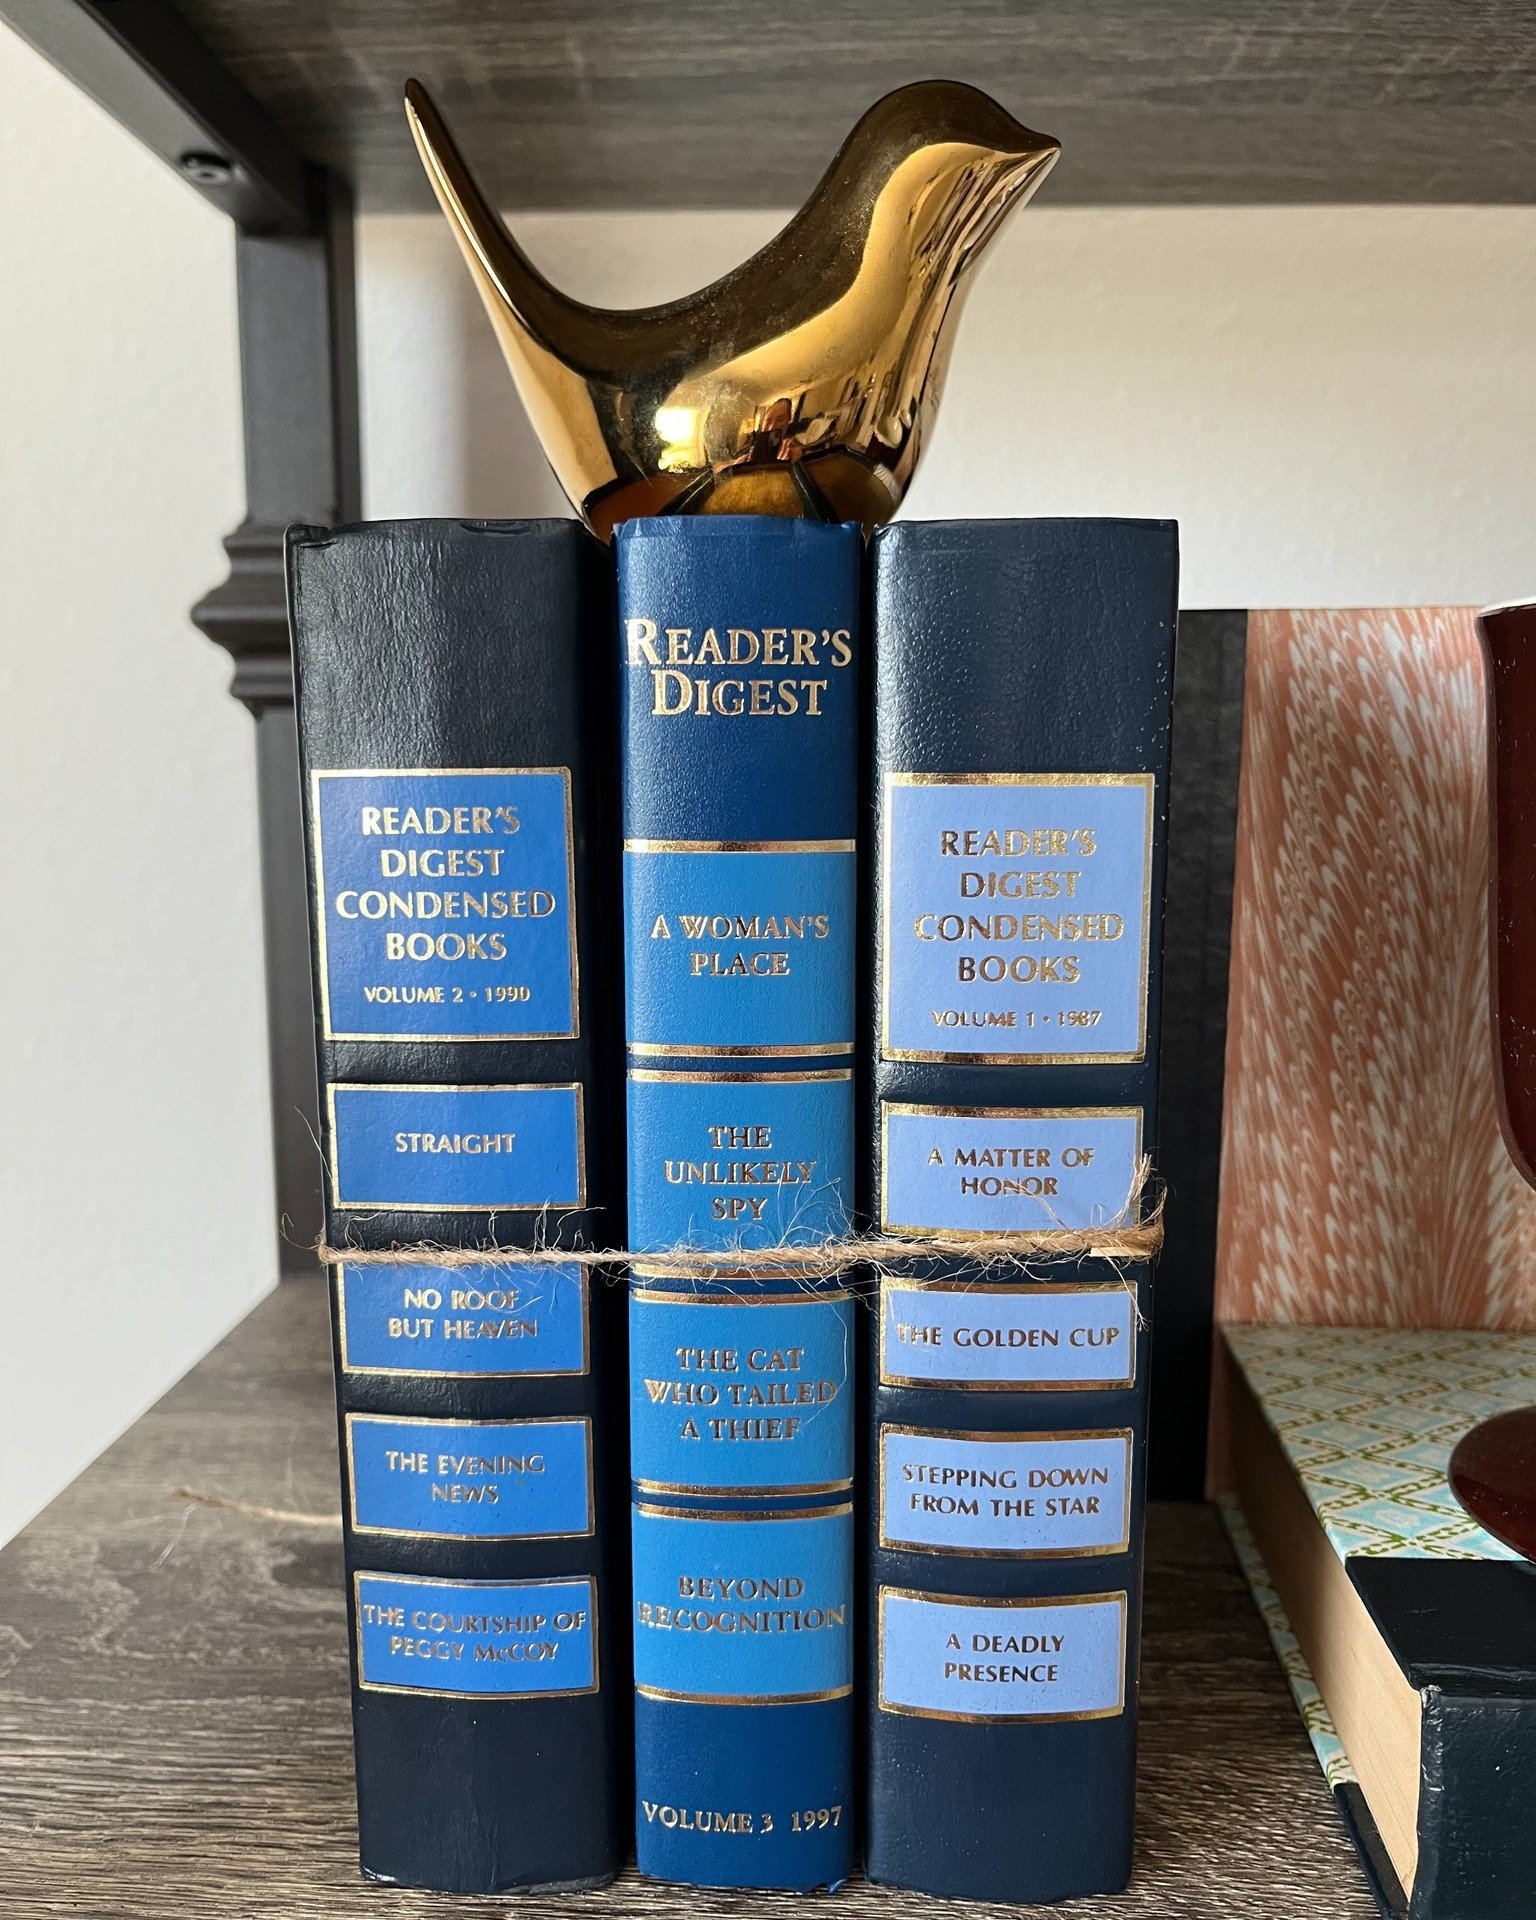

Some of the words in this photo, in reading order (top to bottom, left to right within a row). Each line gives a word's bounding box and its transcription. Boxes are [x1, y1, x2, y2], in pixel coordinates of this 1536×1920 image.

[624, 618, 852, 667] READER'S
[650, 669, 828, 716] DIGEST
[361, 806, 520, 835] READER'S
[940, 828, 1097, 857] READER'S
[380, 849, 504, 877] DIGEST
[960, 871, 1081, 899] DIGEST
[335, 890, 556, 919] CONDENSED
[651, 915, 671, 939] A
[679, 914, 830, 940] WOMAN'S
[914, 913, 1125, 942] CONDENSED
[386, 933, 507, 961] BOOKS
[690, 952, 790, 976] PLACE
[958, 956, 1081, 983] BOOKS
[363, 986, 445, 1003] VOLUME
[452, 987, 464, 1003] 2
[485, 986, 530, 1002] 1990
[931, 1010, 1017, 1028] VOLUME
[1026, 1012, 1036, 1027] 1
[1057, 1010, 1102, 1028] 1987
[395, 1133, 516, 1154] STRAIGHT
[707, 1126, 773, 1150] THE
[927, 1146, 944, 1166] A
[954, 1147, 1051, 1168] MATTER
[1061, 1148, 1095, 1168] OF
[663, 1160, 817, 1185] UNLIKELY
[961, 1177, 1058, 1196] HONOR
[711, 1197, 768, 1221] SPY
[403, 1288, 442, 1310] NO
[451, 1289, 519, 1310] ROOF
[388, 1318, 434, 1338] BUT
[444, 1319, 538, 1340] HEAVEN
[896, 1323, 942, 1346] THE
[953, 1328, 1059, 1347] GOLDEN
[1069, 1327, 1120, 1346] CUP
[675, 1347, 739, 1372] THE
[747, 1347, 805, 1372] CAT
[643, 1378, 720, 1406] WHO
[728, 1382, 839, 1407] TAILED
[680, 1418, 700, 1441] A
[709, 1417, 801, 1441] THIEF
[385, 1451, 428, 1473] THE
[438, 1453, 545, 1475] EVENING
[903, 1464, 1017, 1489] STEPPING
[1028, 1467, 1109, 1488] DOWN
[431, 1482, 498, 1505] NEWS
[911, 1493, 979, 1516] FROM
[990, 1499, 1035, 1517] THE
[1045, 1496, 1100, 1516] STAR
[678, 1576, 804, 1600] BEYOND
[363, 1604, 405, 1627] THE
[411, 1610, 547, 1634] COURTSHIP
[553, 1611, 586, 1631] OF
[637, 1600, 848, 1634] RECOGNITION
[390, 1635, 465, 1660] PEGGY
[474, 1642, 559, 1663] McCOY
[945, 1633, 961, 1650] A
[972, 1634, 1065, 1653] DEADLY
[944, 1662, 1058, 1682] PRESENCE
[642, 1800, 754, 1834] VOLUME
[760, 1813, 774, 1834] 3
[791, 1806, 842, 1832] 1997
